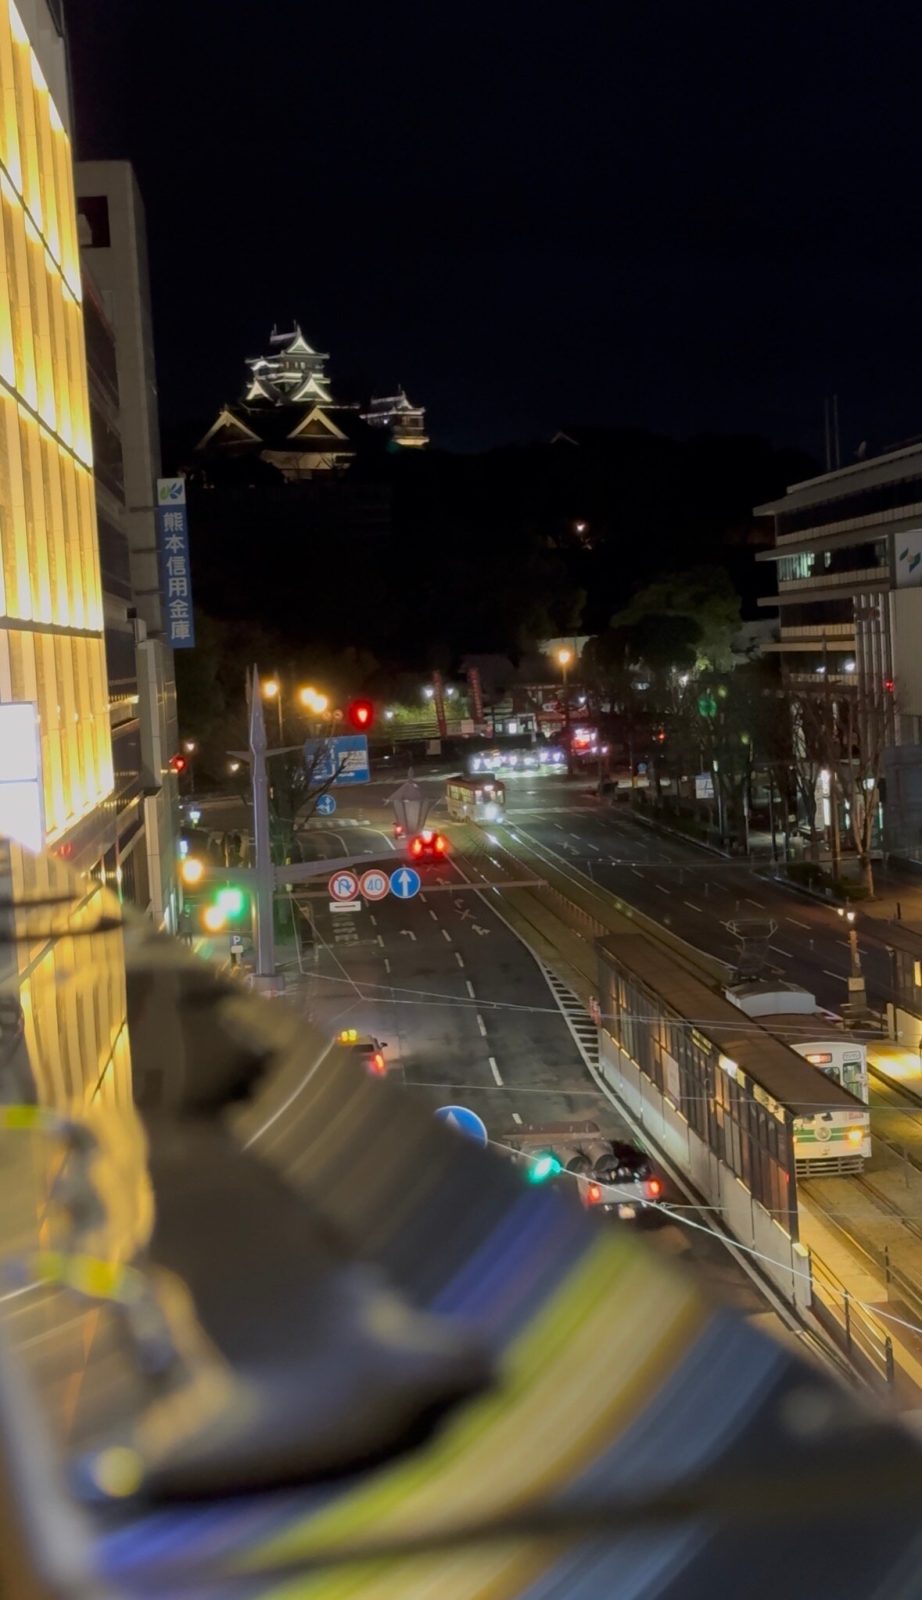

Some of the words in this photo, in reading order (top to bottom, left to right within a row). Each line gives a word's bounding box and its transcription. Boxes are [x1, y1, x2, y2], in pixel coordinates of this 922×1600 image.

[163, 512, 191, 640] 熊本信用金庫
[367, 878, 383, 891] 40
[233, 935, 241, 945] P
